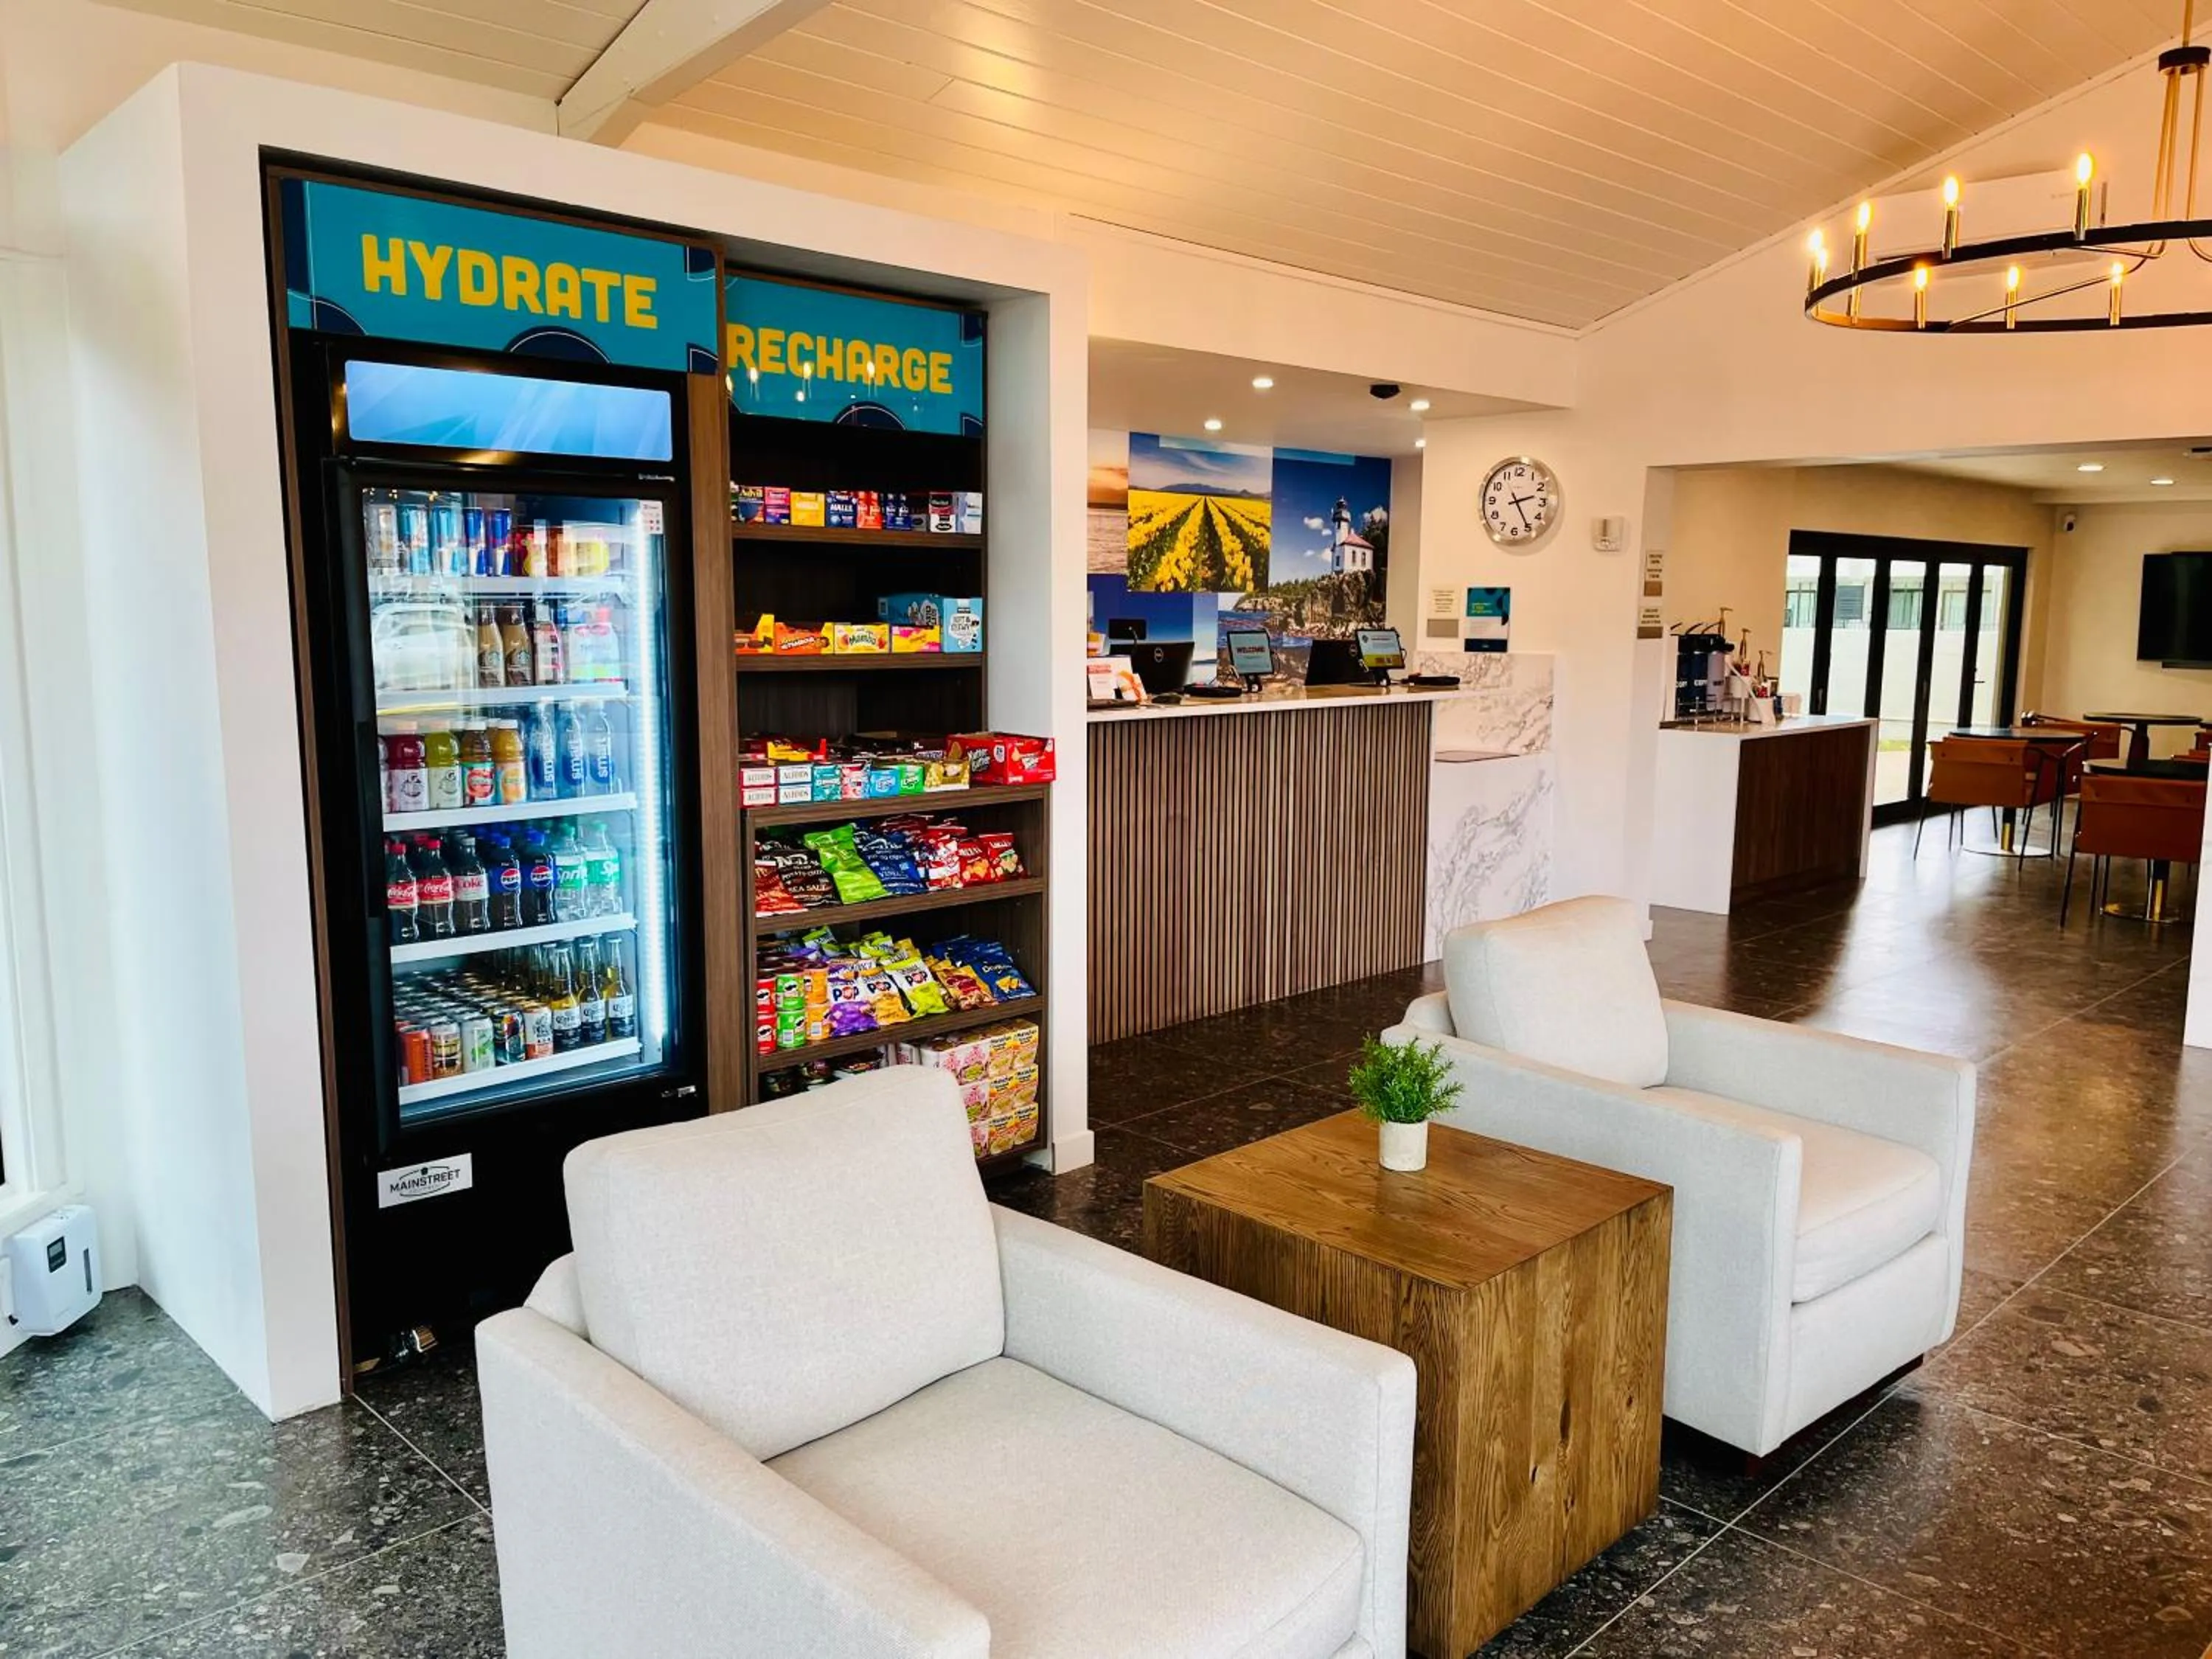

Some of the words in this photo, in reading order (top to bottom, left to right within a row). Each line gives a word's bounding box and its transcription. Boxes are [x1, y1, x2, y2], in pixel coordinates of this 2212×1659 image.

[361, 233, 658, 330] HYDRATE
[726, 322, 954, 394] RECHARGE
[1503, 471, 1511, 481] 11
[1514, 467, 1526, 477] 12
[1493, 481, 1503, 491] 10
[1536, 482, 1545, 492] 2
[1488, 496, 1496, 505] 9
[1538, 498, 1547, 507] 3
[1490, 510, 1499, 520] 8
[1534, 512, 1542, 521] 4
[1499, 522, 1506, 531] 7
[1510, 527, 1518, 536] 6
[1236, 646, 1265, 654] WELCOME
[904, 971, 928, 987] POP
[867, 981, 891, 994] POP
[832, 986, 860, 1001] POP
[389, 1168, 460, 1194] MAINSTREET
